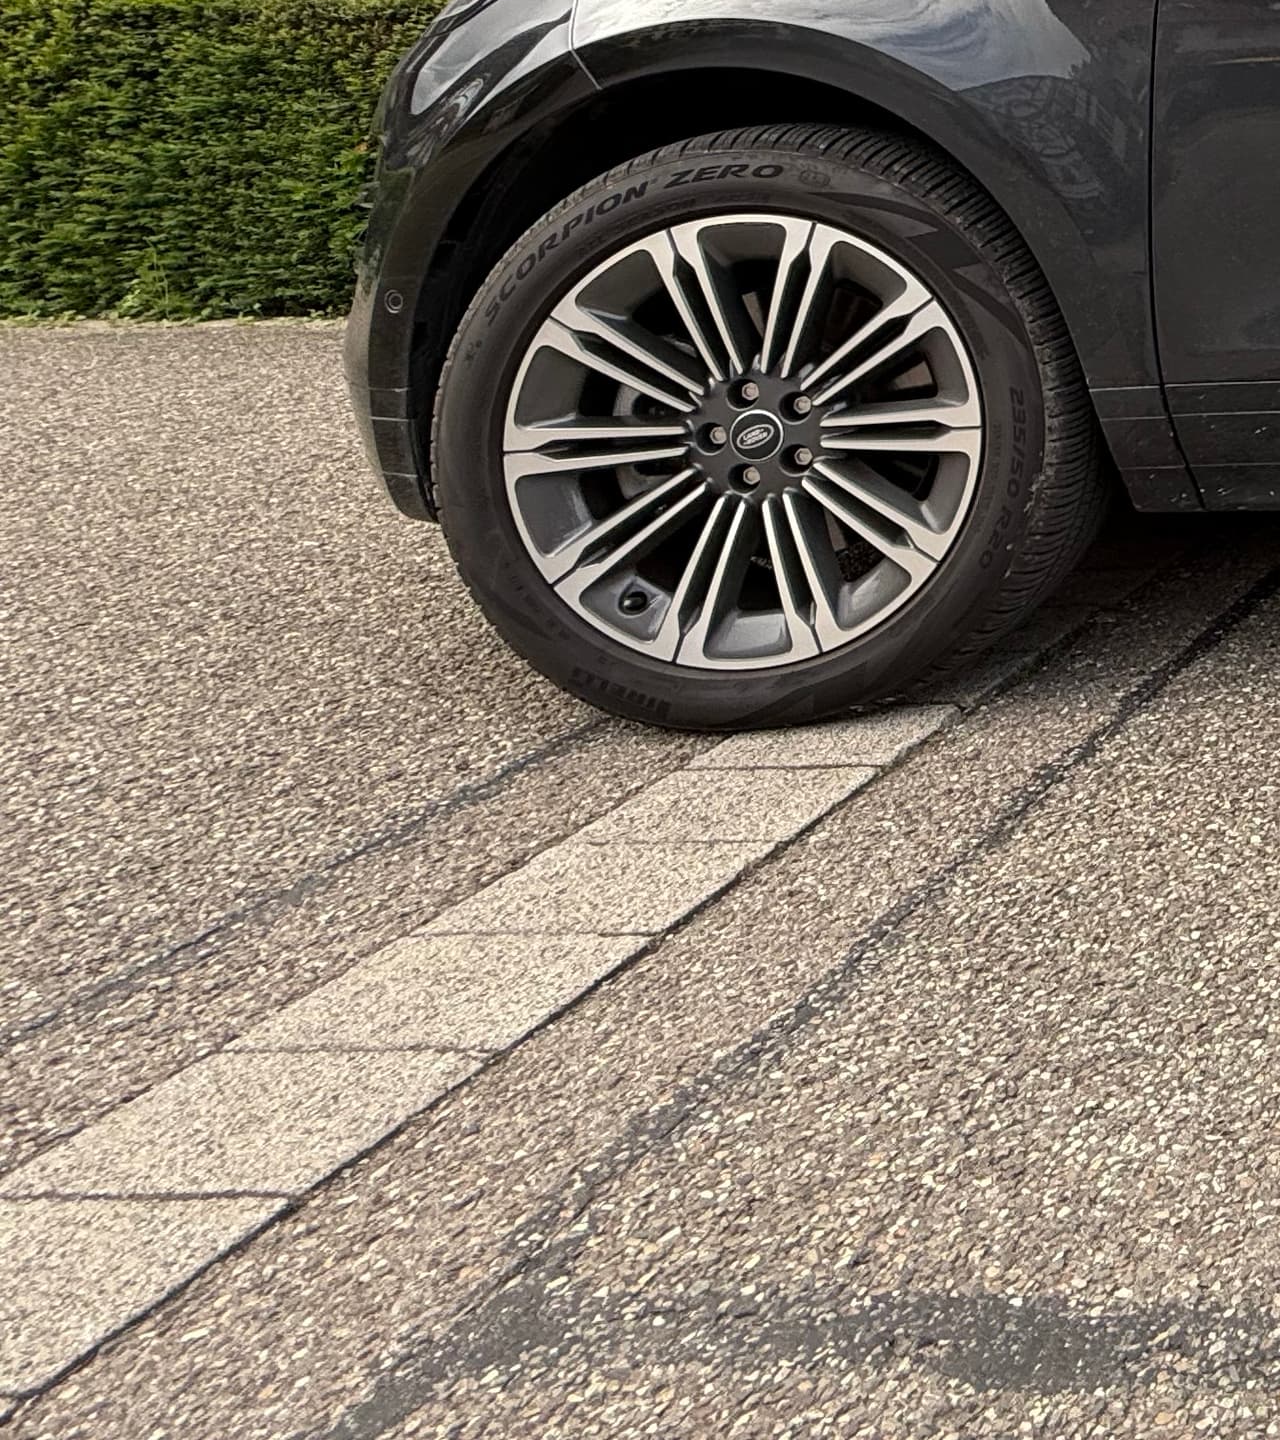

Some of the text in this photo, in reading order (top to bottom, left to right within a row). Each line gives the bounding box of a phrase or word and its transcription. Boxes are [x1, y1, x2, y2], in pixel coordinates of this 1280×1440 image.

[485, 181, 650, 327] SCORPION
[664, 164, 784, 190] ZERO
[1008, 386, 1028, 499] 235/50
